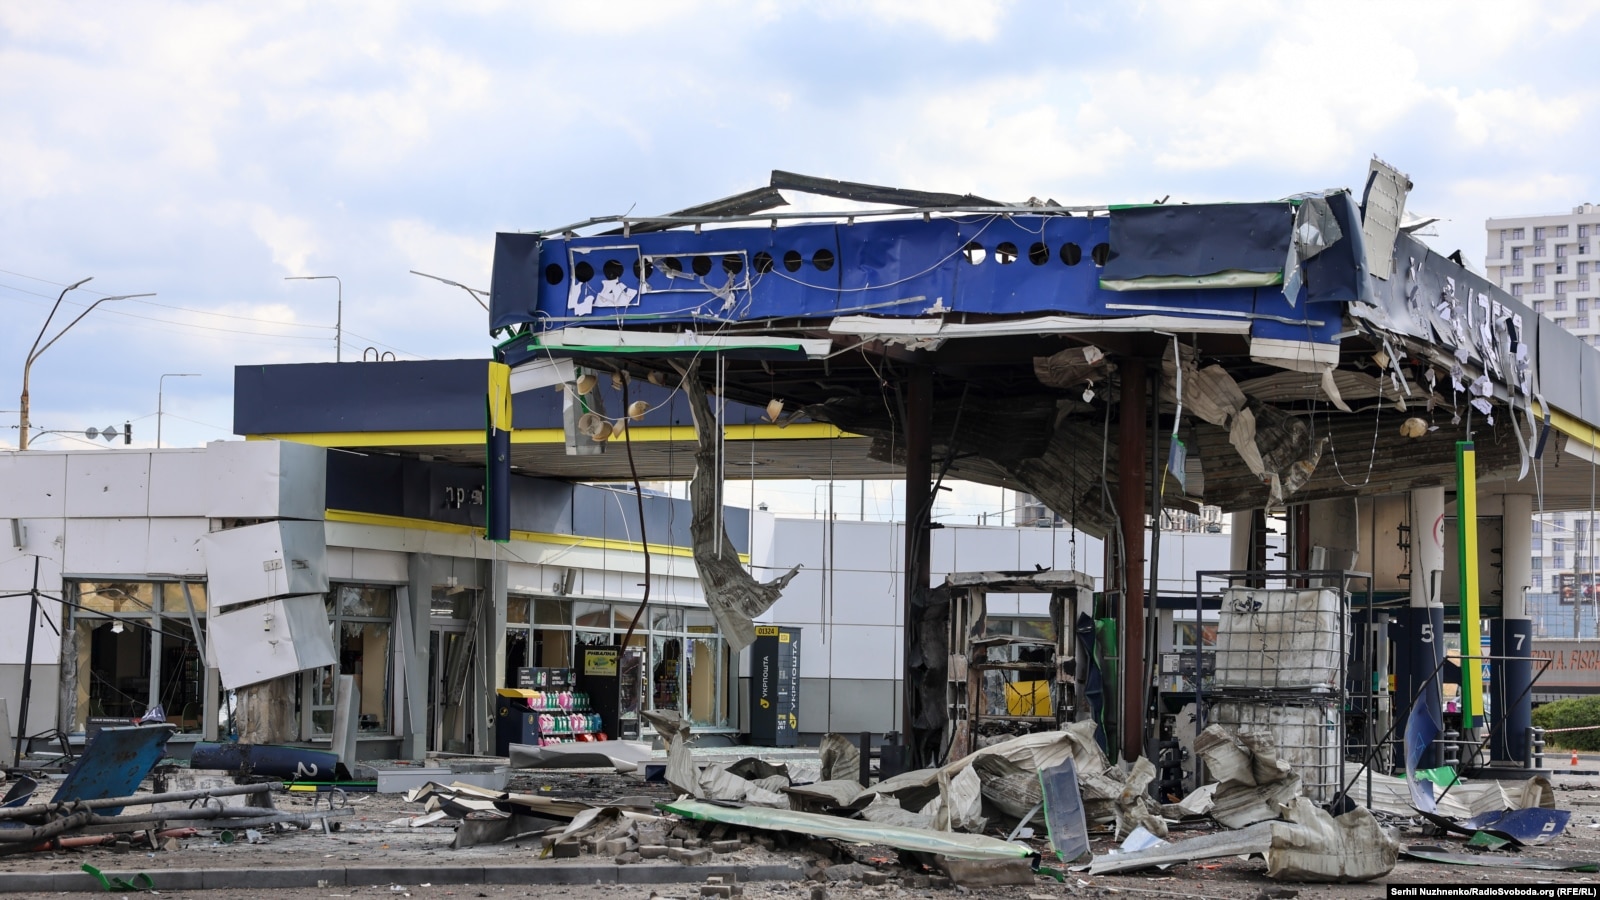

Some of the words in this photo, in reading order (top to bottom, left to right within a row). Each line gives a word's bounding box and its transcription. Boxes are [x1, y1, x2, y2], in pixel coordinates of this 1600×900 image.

[758, 627, 775, 635] 01324
[1420, 624, 1435, 643] 5
[1513, 633, 1526, 651] 7
[1556, 650, 1567, 671] A.
[790, 640, 798, 710] УКРПОШТА
[297, 761, 319, 777] 2
